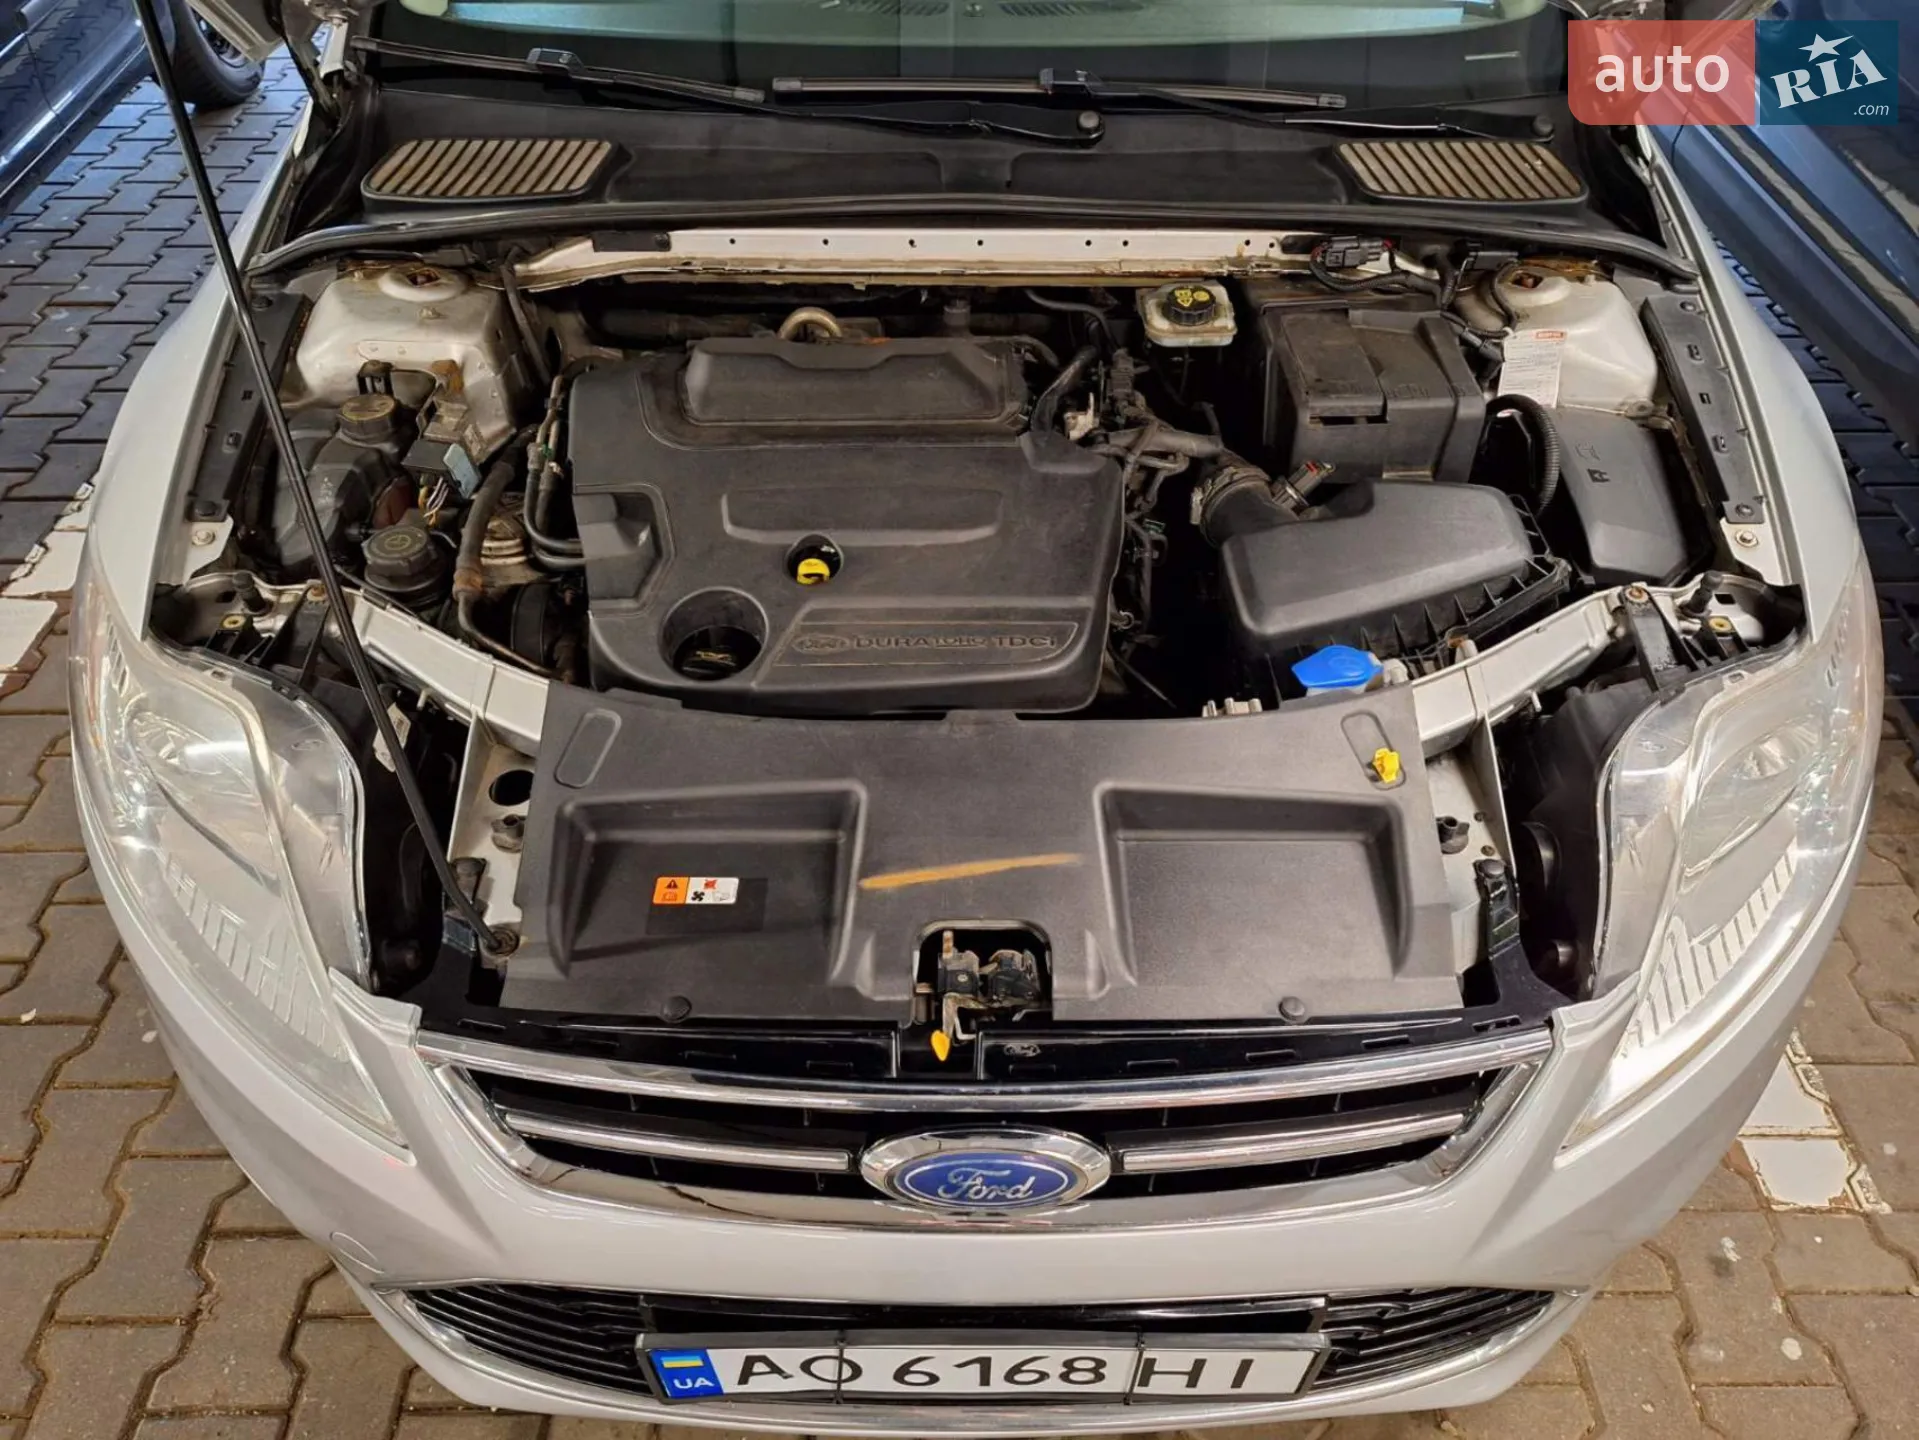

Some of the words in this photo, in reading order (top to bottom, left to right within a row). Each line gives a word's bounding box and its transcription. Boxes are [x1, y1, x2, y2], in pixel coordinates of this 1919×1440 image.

[937, 1167, 1036, 1199] Ford
[673, 1376, 715, 1389] UA
[737, 1355, 863, 1385] AO
[893, 1355, 1107, 1387] 6168
[1137, 1358, 1255, 1389] HI
